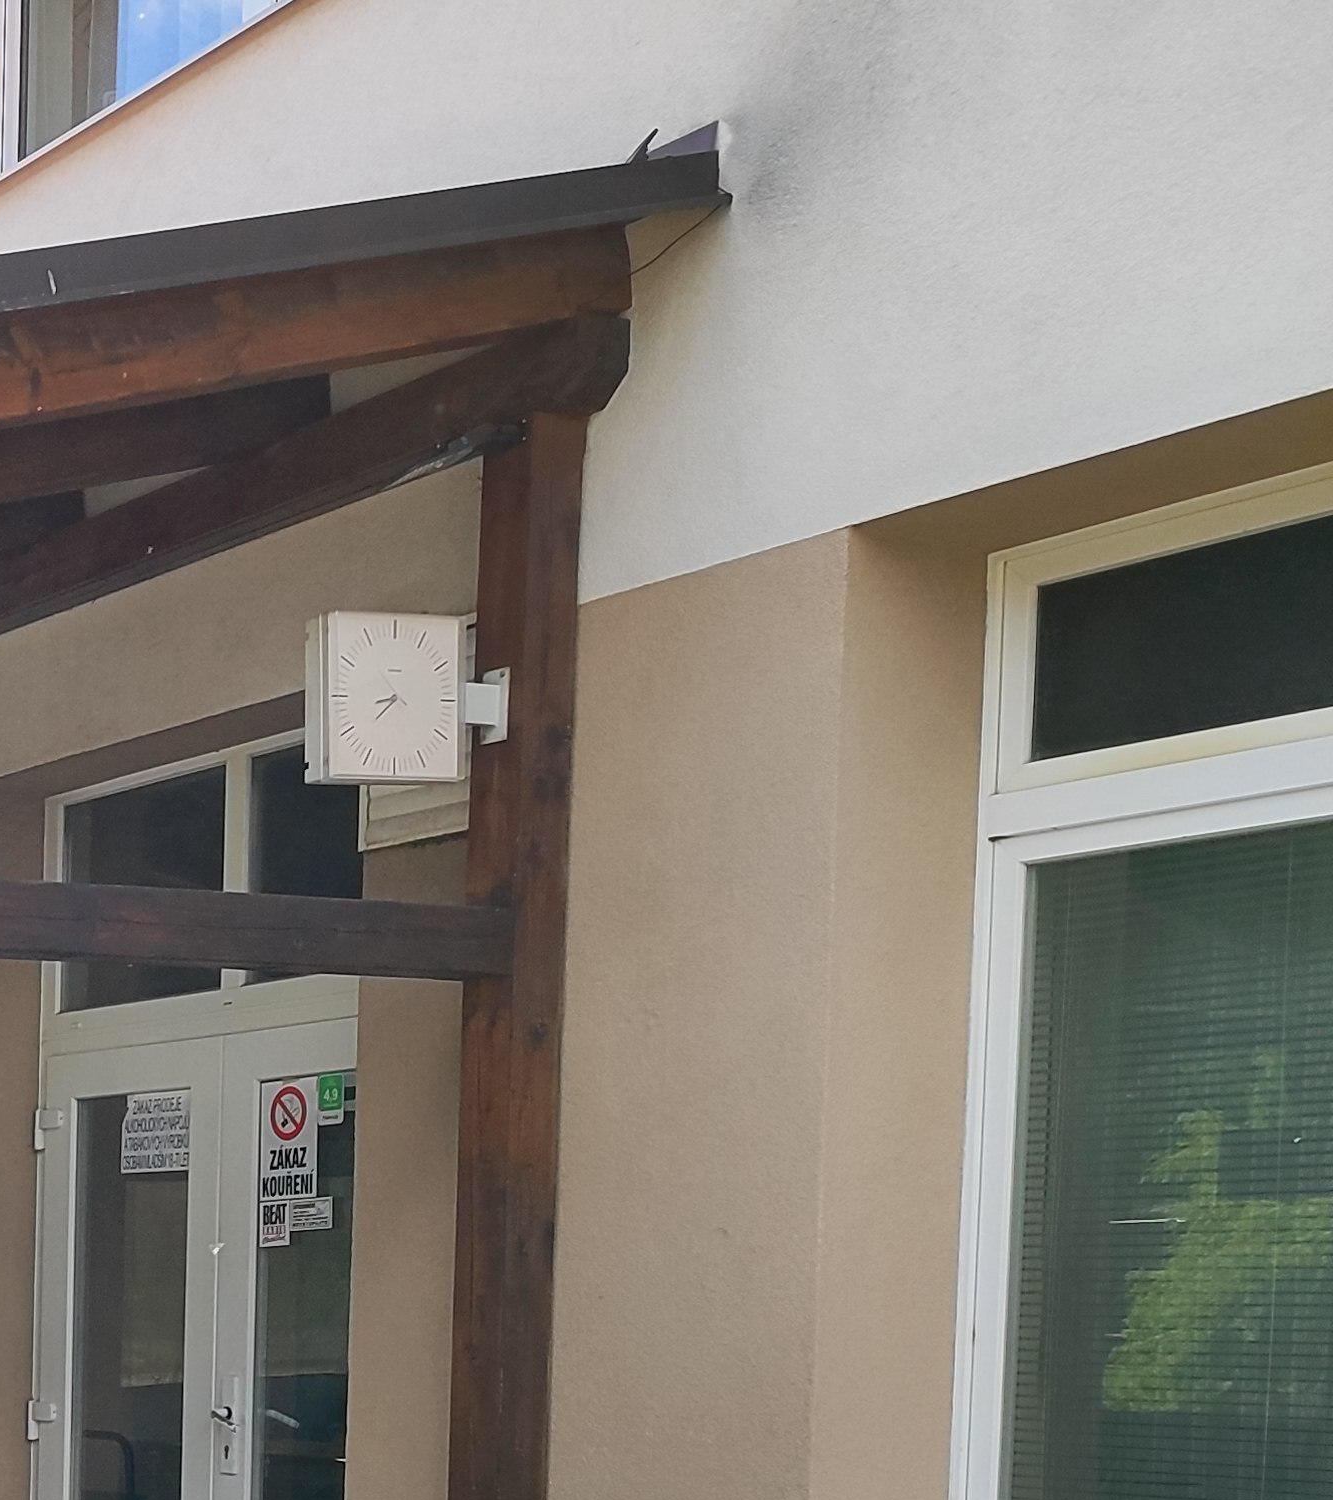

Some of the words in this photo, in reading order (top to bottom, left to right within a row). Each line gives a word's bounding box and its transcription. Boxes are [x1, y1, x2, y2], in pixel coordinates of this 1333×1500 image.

[270, 1145, 307, 1170] ZÁKAZ
[262, 1169, 314, 1198] KOUŘENÍ
[263, 1203, 287, 1225] BEAT
